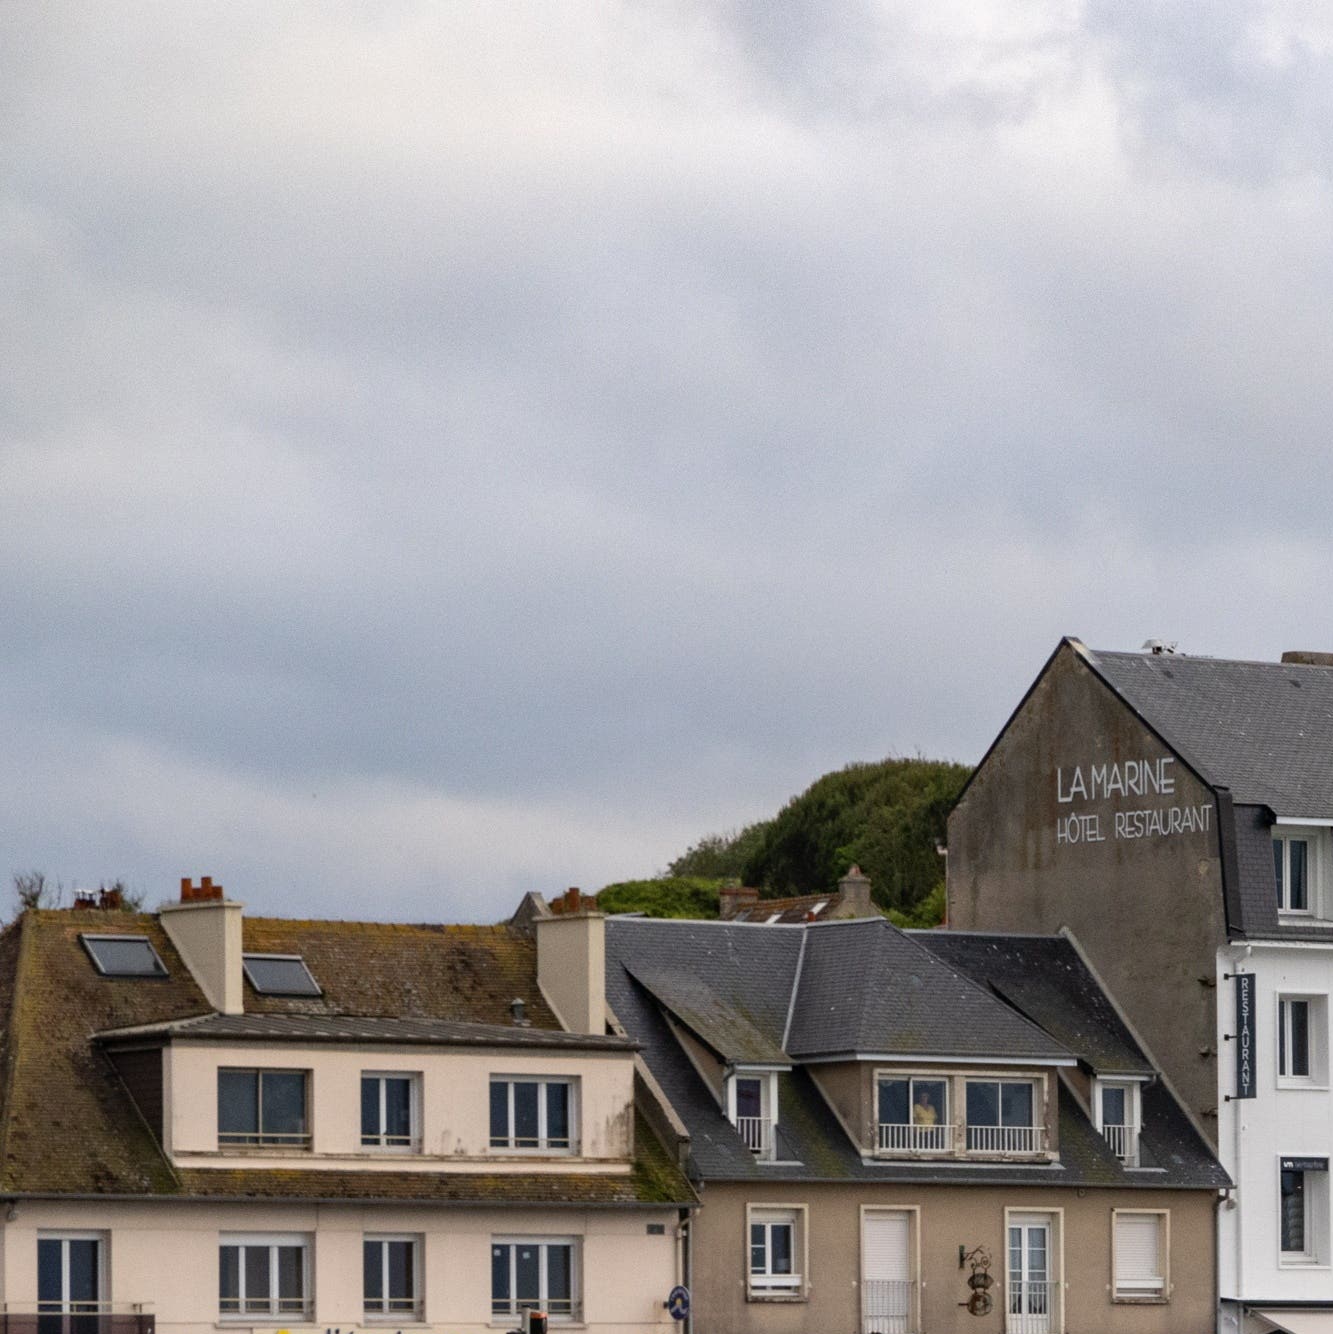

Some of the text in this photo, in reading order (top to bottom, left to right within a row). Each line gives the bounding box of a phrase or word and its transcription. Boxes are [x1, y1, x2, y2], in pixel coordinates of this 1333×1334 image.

[1058, 757, 1175, 804] LA MARINE
[1058, 804, 1213, 844] HÔTEL RESTAURANT
[1241, 977, 1250, 1096] RESTAURANT
